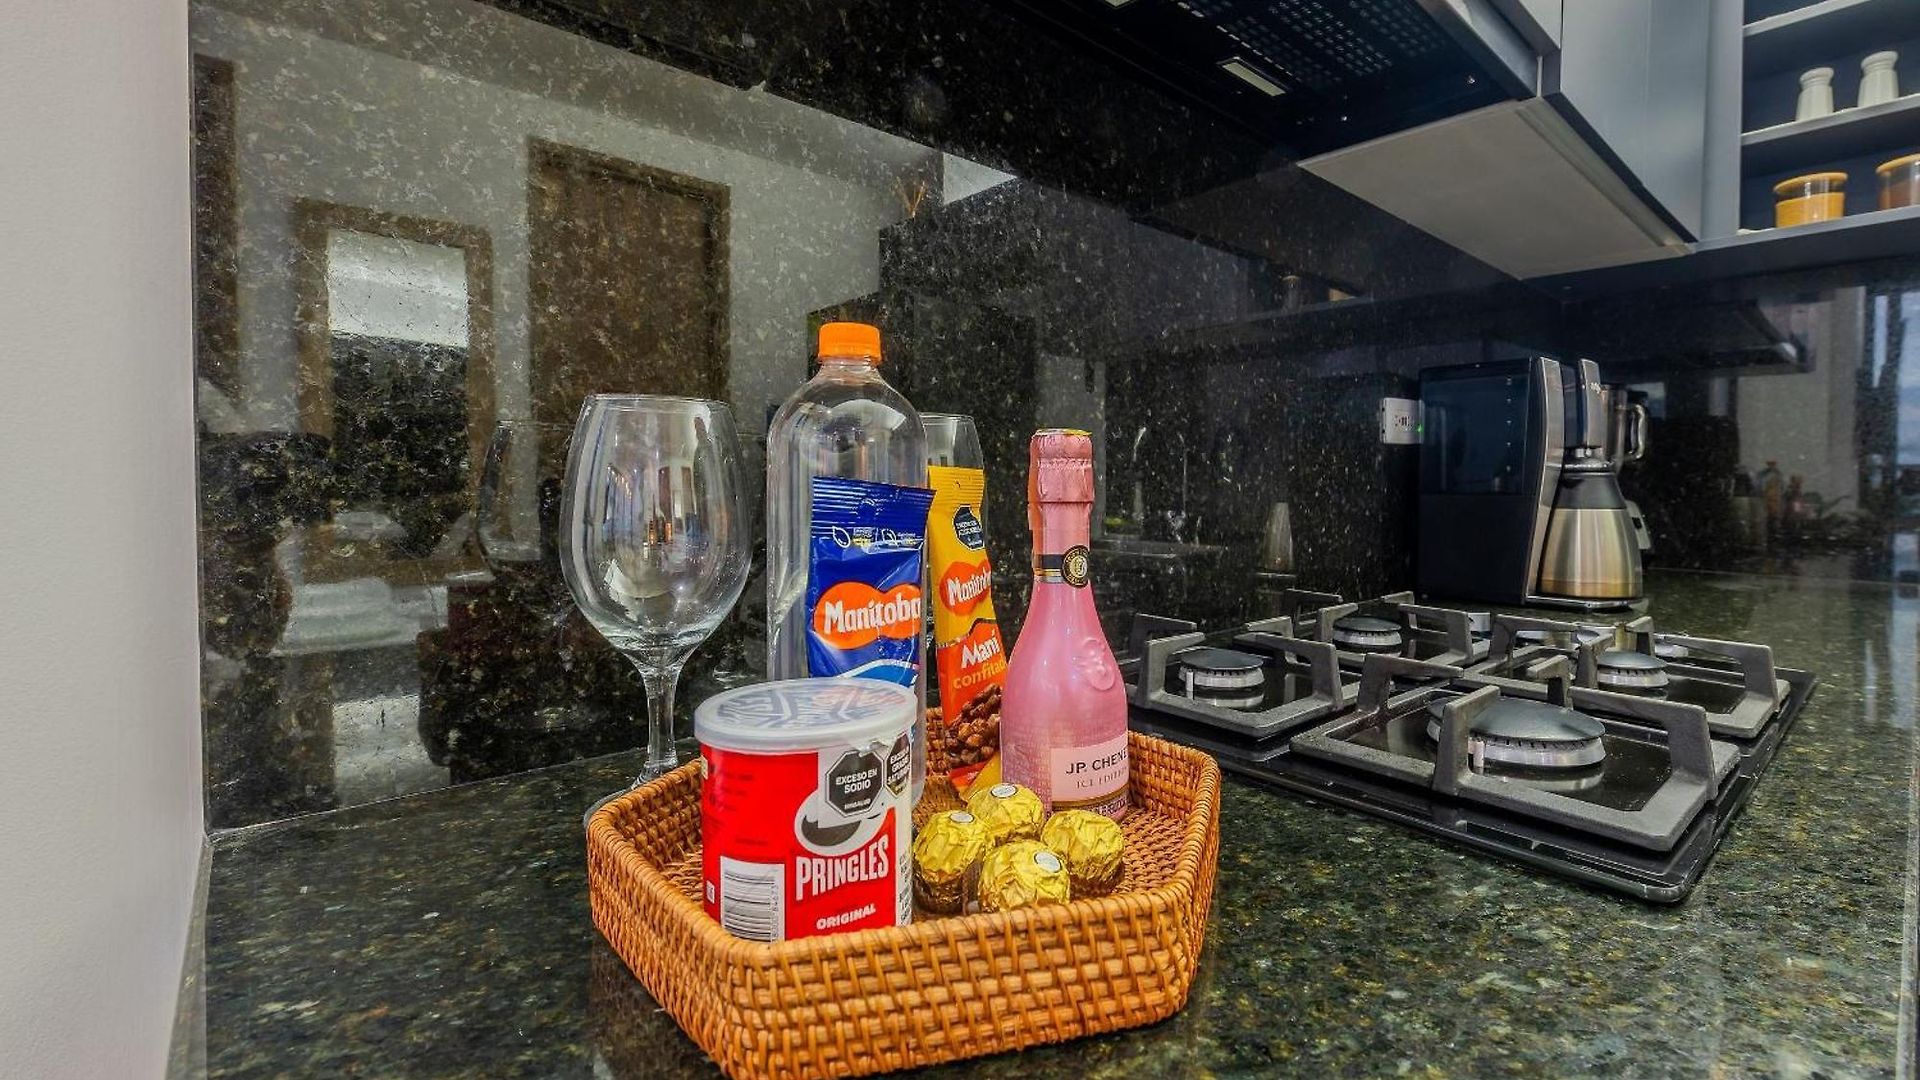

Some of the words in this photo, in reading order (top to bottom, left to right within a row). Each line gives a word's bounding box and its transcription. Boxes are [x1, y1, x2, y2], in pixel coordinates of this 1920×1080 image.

[835, 771, 867, 786] EXCESO
[867, 768, 878, 779] EN
[844, 779, 871, 794] SODIO
[795, 834, 889, 901] PRINGLES
[816, 903, 877, 930] ORIGINAL
